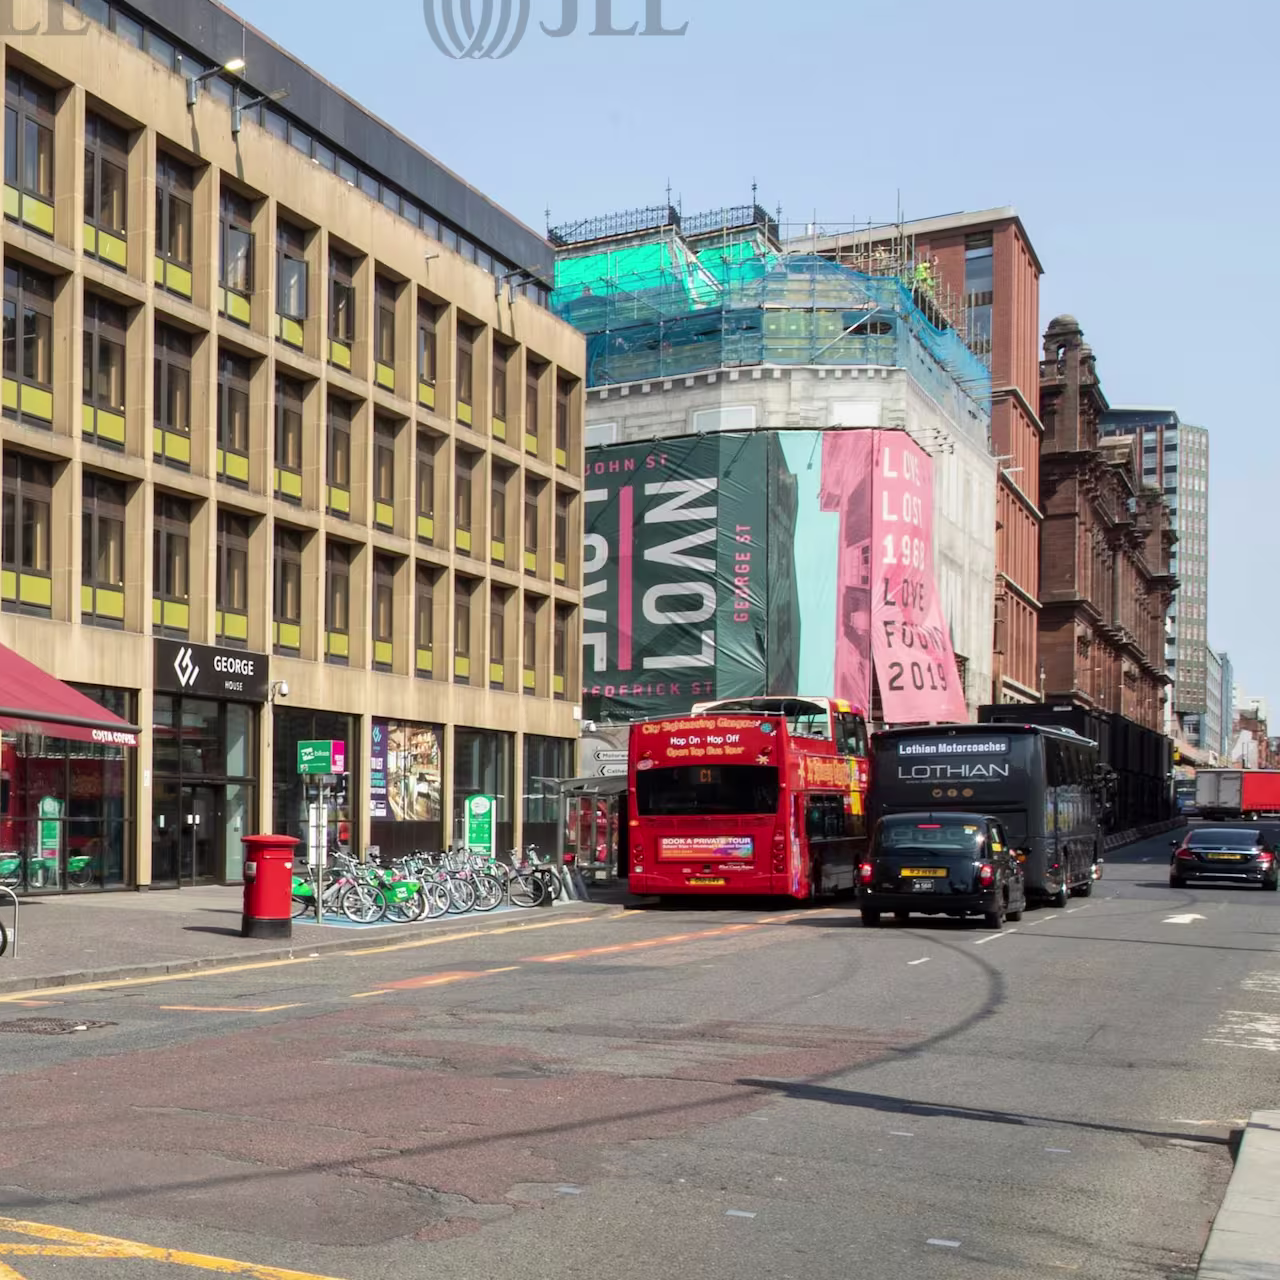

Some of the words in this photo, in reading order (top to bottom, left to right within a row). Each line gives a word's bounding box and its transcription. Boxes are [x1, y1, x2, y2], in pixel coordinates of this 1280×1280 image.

[882, 447, 921, 487] LOVE
[882, 491, 923, 529] LOST
[882, 533, 925, 571] 1968
[733, 552, 752, 622] GEORGE
[883, 577, 925, 612] LOVE
[883, 621, 947, 652] FOUND
[213, 655, 254, 676] GEORGE
[888, 661, 948, 692] 2019
[224, 681, 243, 691] HOUSE
[691, 681, 713, 696] ST
[92, 729, 114, 742] COSTA
[642, 723, 661, 734] City
[662, 719, 716, 732] Sightseeing
[670, 736, 687, 746] Hop
[688, 735, 701, 745] On
[707, 734, 724, 744] Hop
[726, 734, 740, 742] Off
[899, 743, 937, 755] Lothian
[938, 741, 1006, 753] Motorcoaches
[666, 747, 689, 757] Open
[690, 746, 705, 756] Top
[706, 746, 724, 755] Bus
[724, 745, 745, 755] Tour
[898, 763, 1009, 779] LOTHIAN
